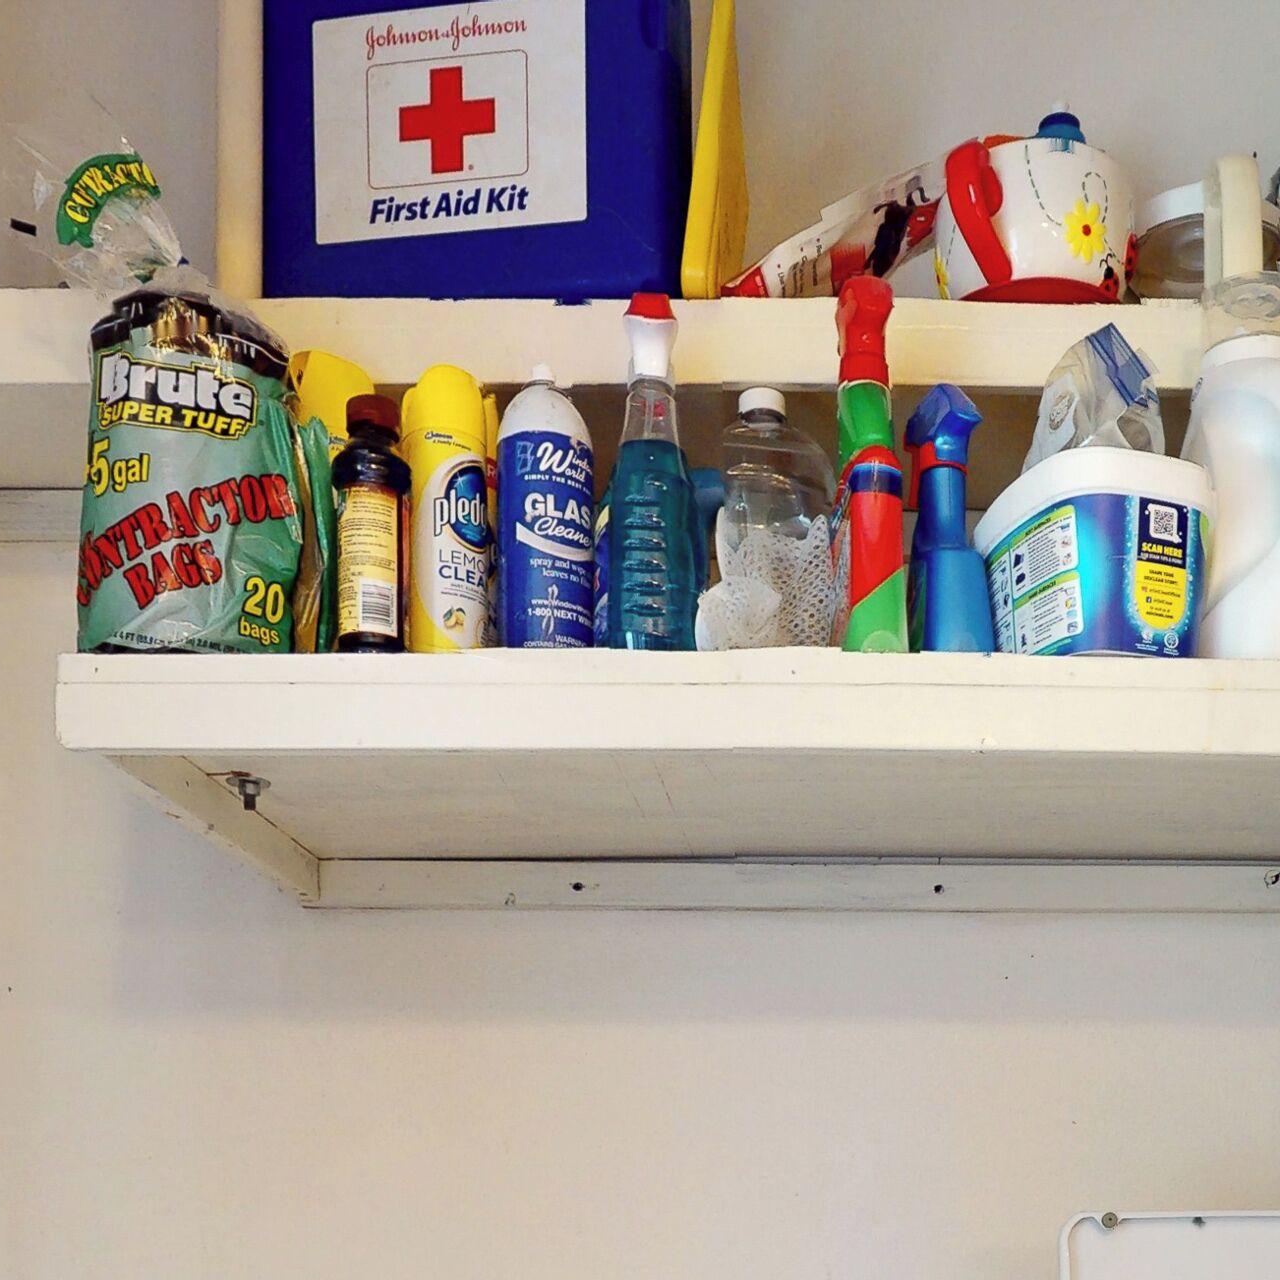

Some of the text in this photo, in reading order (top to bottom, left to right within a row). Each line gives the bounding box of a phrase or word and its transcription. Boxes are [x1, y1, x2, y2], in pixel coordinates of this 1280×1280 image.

[366, 15, 527, 60] Johnson Johnson
[370, 184, 529, 224] First Aid Kit
[100, 353, 254, 421] Brute
[180, 408, 248, 437] TUFF
[113, 453, 150, 493] gal
[77, 473, 299, 607] CONTRACTOR
[1141, 542, 1183, 558] SCAN HERE
[122, 538, 222, 610] BAGS
[529, 557, 570, 569] spray and
[542, 568, 569, 579] leaves
[243, 575, 285, 624] 20
[527, 608, 578, 621] 1-800 NEXT
[239, 615, 281, 647] bags
